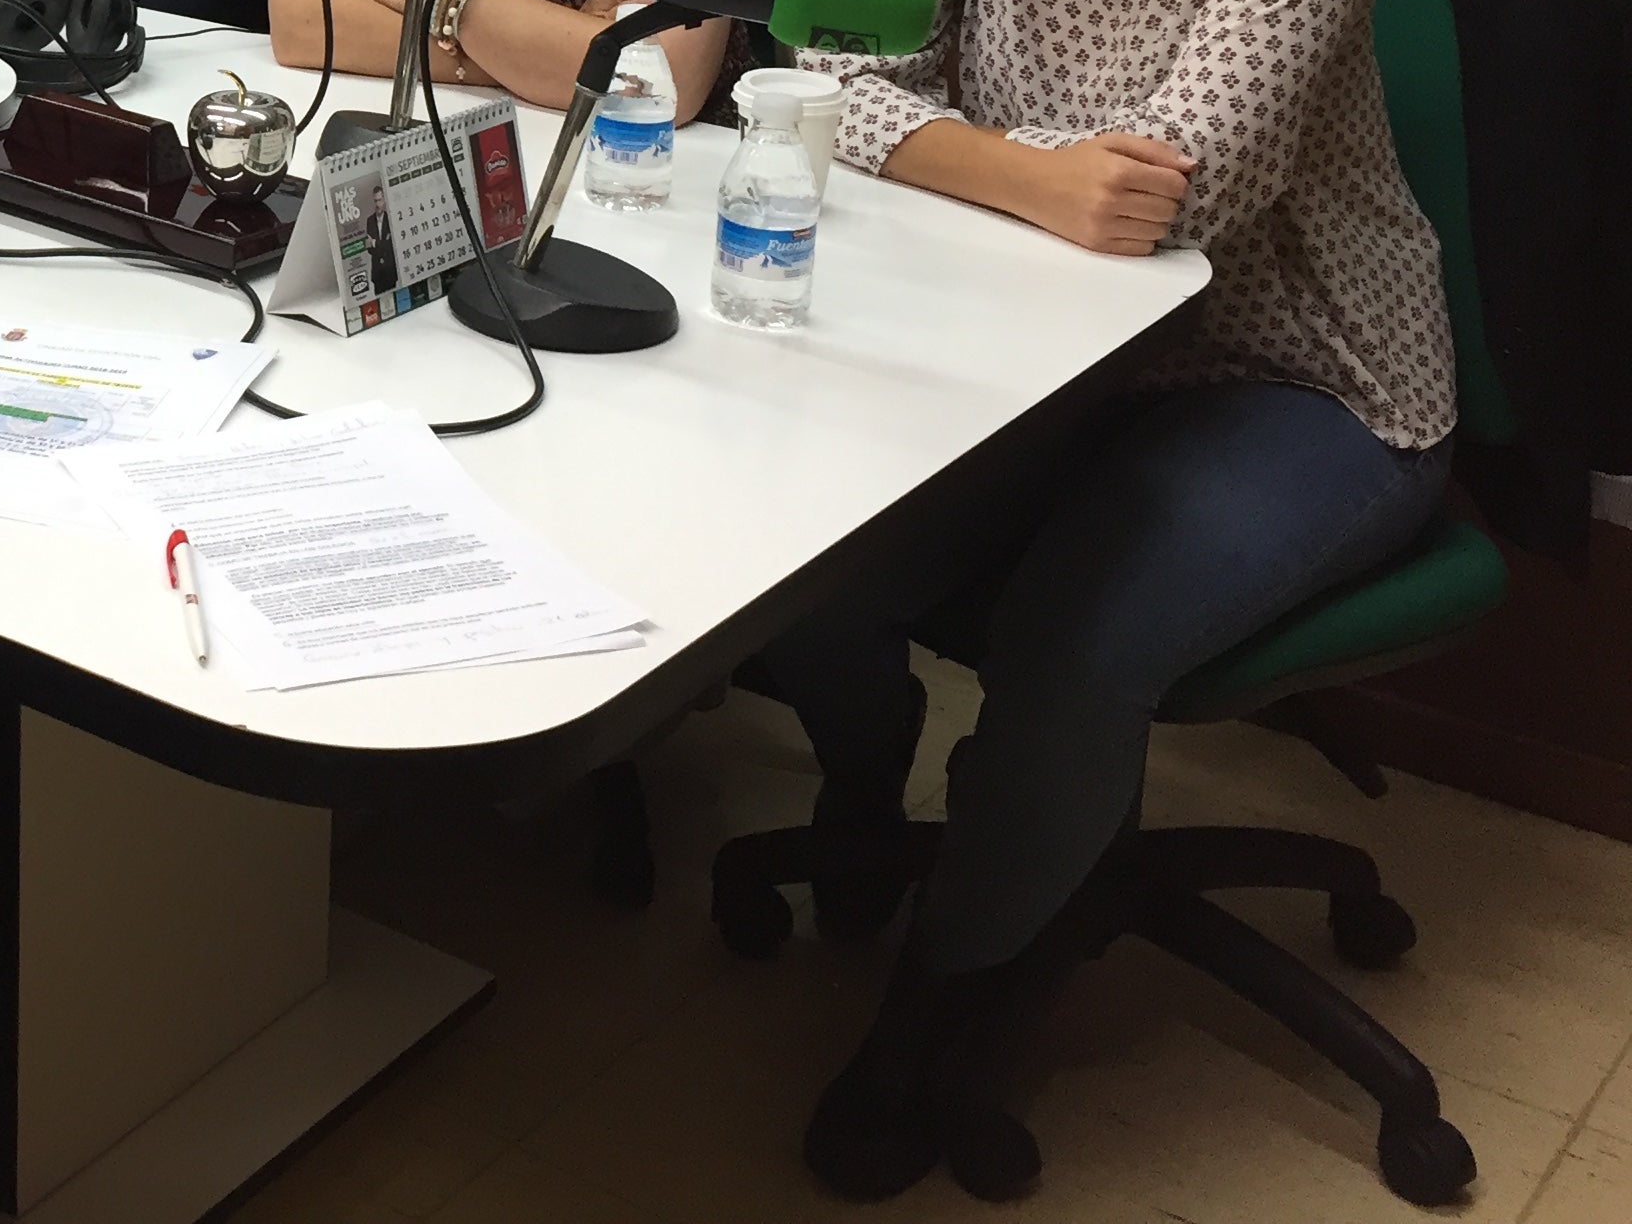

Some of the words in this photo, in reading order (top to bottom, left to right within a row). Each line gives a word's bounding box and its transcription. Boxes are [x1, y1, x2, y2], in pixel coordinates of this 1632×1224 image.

[398, 149, 442, 172] SEPTIEMBR
[338, 206, 360, 225] UNO
[432, 218, 440, 228] 12
[442, 213, 451, 224] 13
[435, 236, 443, 246] 19
[445, 232, 454, 242] 20
[455, 228, 463, 238] 21
[448, 251, 456, 262] 27
[458, 246, 467, 257] 28
